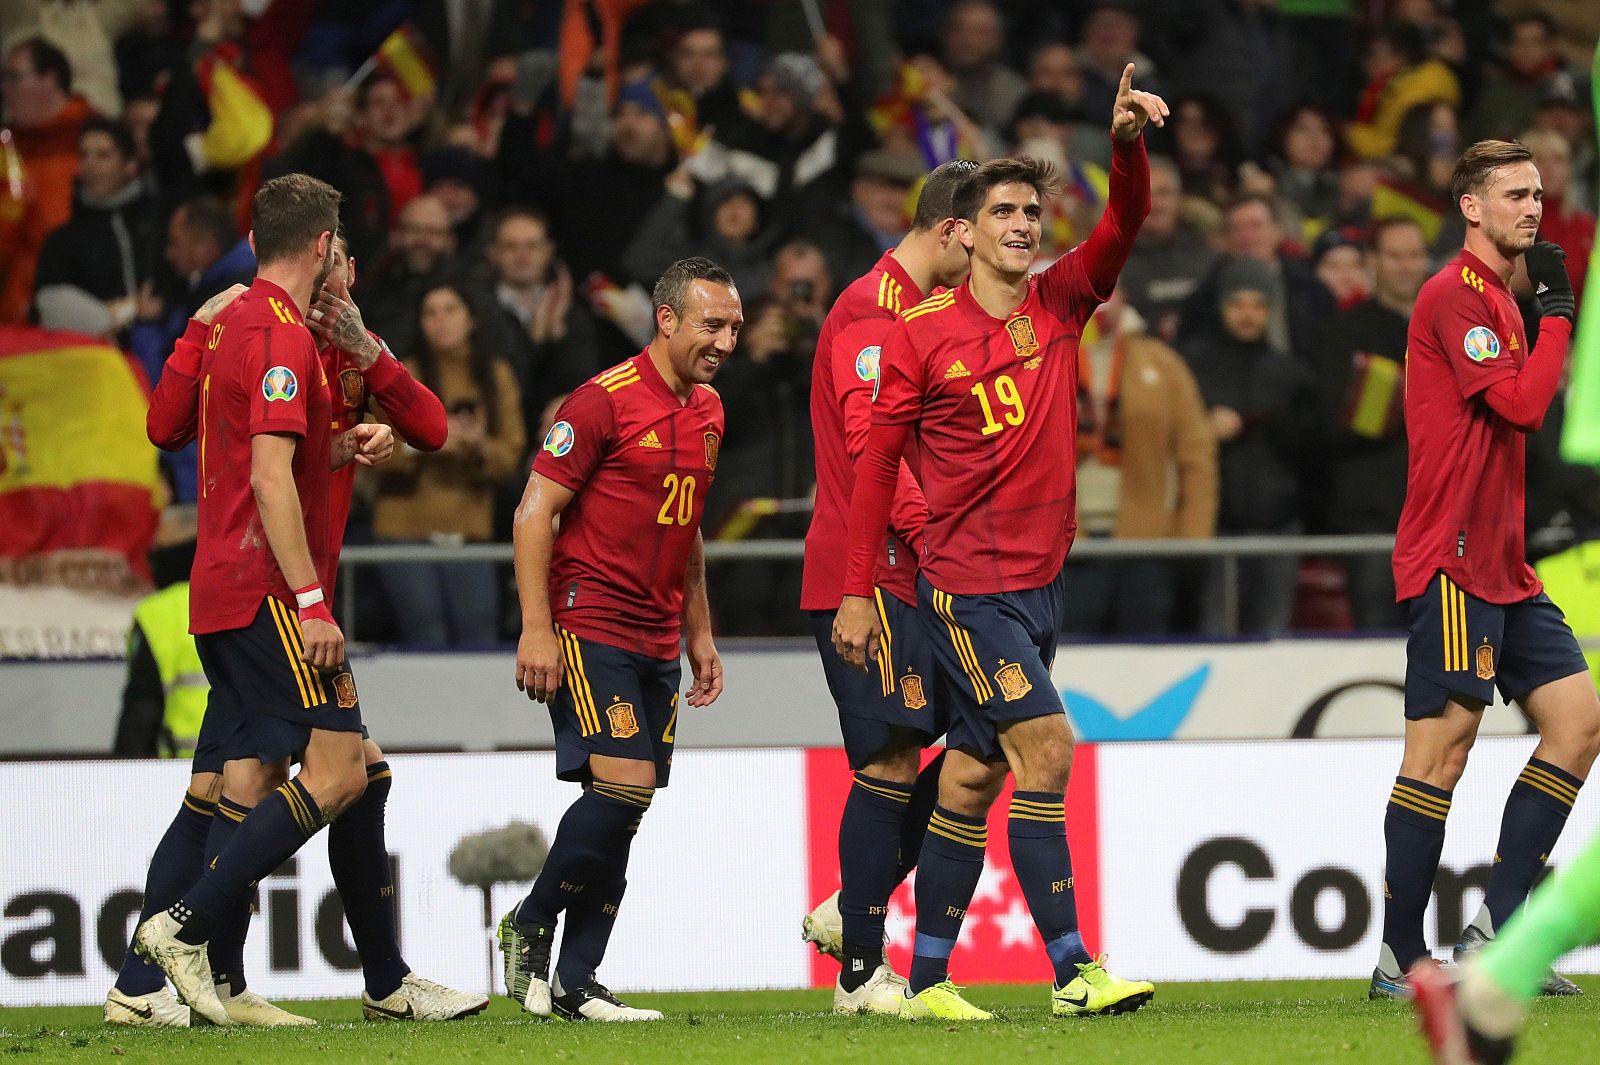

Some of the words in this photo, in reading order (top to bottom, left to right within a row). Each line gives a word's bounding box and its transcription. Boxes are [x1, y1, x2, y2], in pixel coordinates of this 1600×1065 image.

[944, 370, 971, 379] adidas
[971, 375, 1026, 436] 19
[638, 440, 662, 449] adidas
[657, 473, 696, 526] 20
